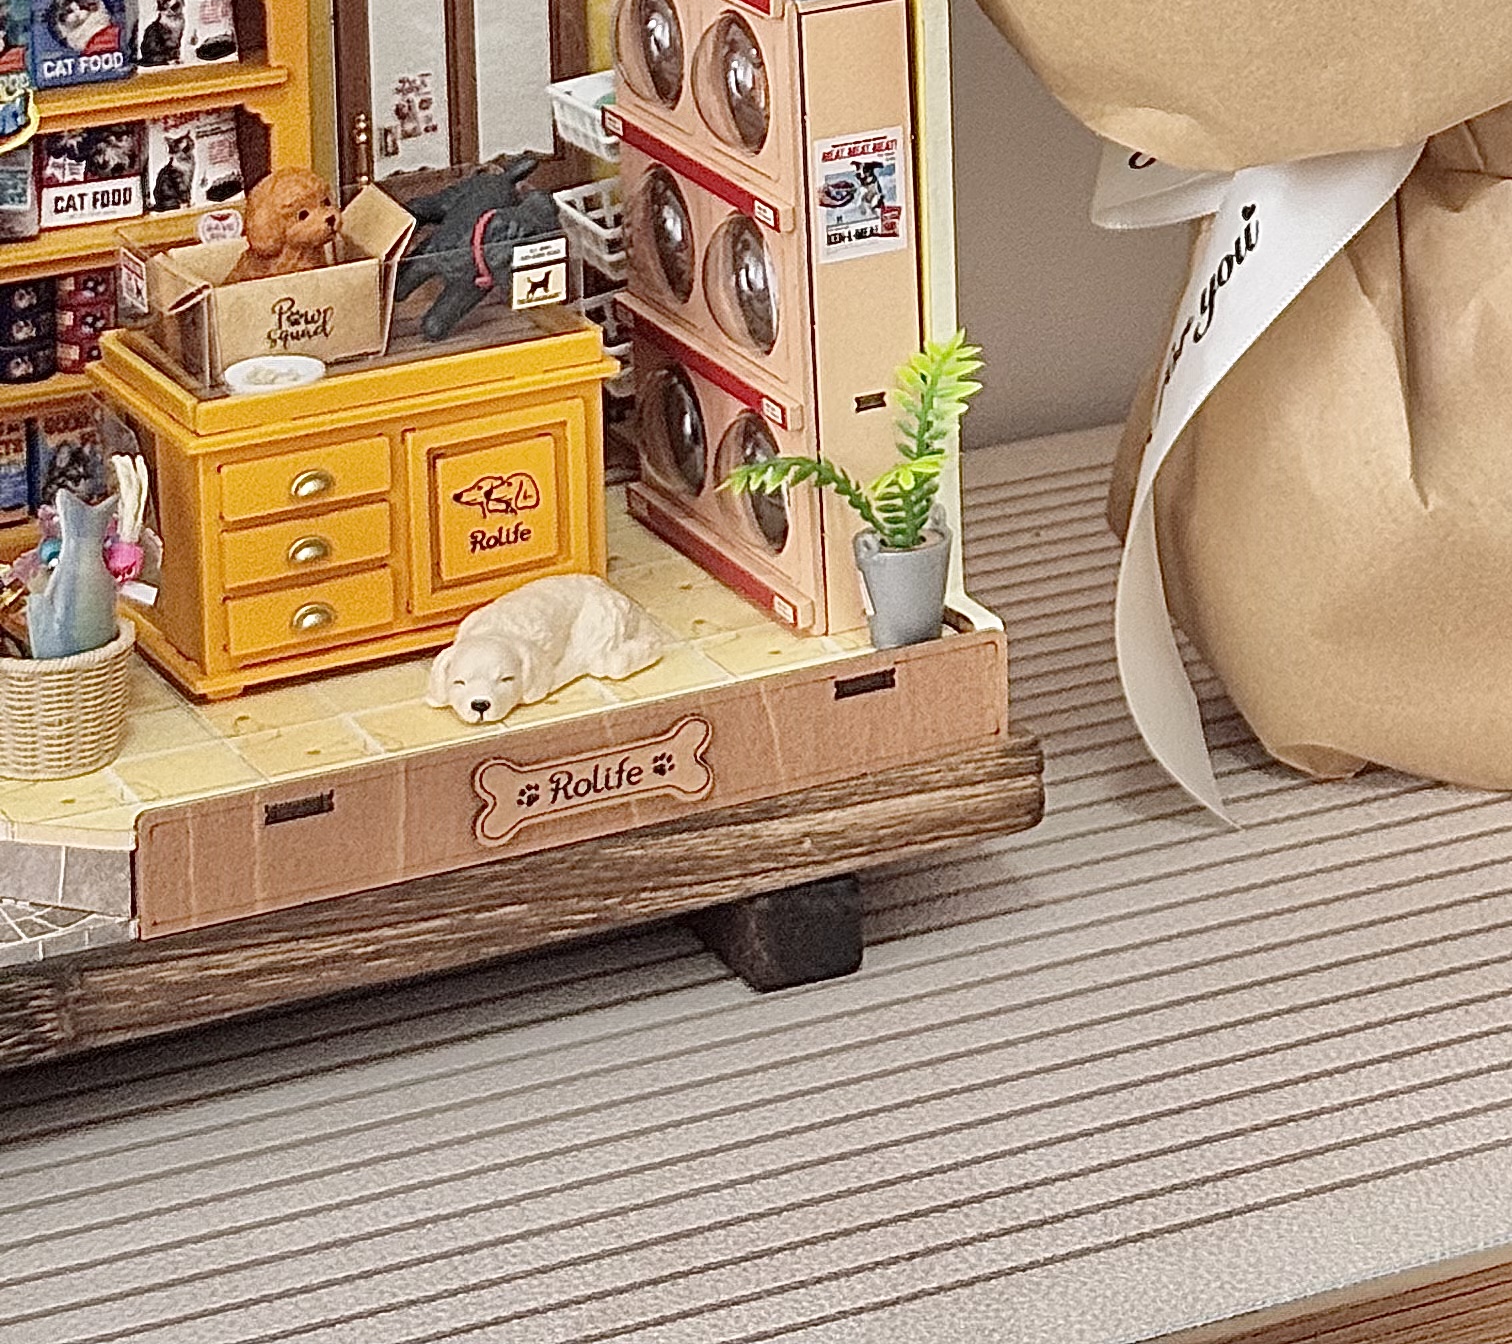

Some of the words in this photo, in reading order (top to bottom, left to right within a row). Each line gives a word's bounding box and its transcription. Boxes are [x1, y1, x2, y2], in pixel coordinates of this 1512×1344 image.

[43, 59, 73, 79] CAT
[80, 52, 124, 76] FOOD
[53, 192, 87, 214] CAT
[92, 187, 133, 208] FOOD
[1194, 218, 1260, 344] you
[469, 520, 532, 553] Rolife
[549, 756, 643, 804] Rolife
